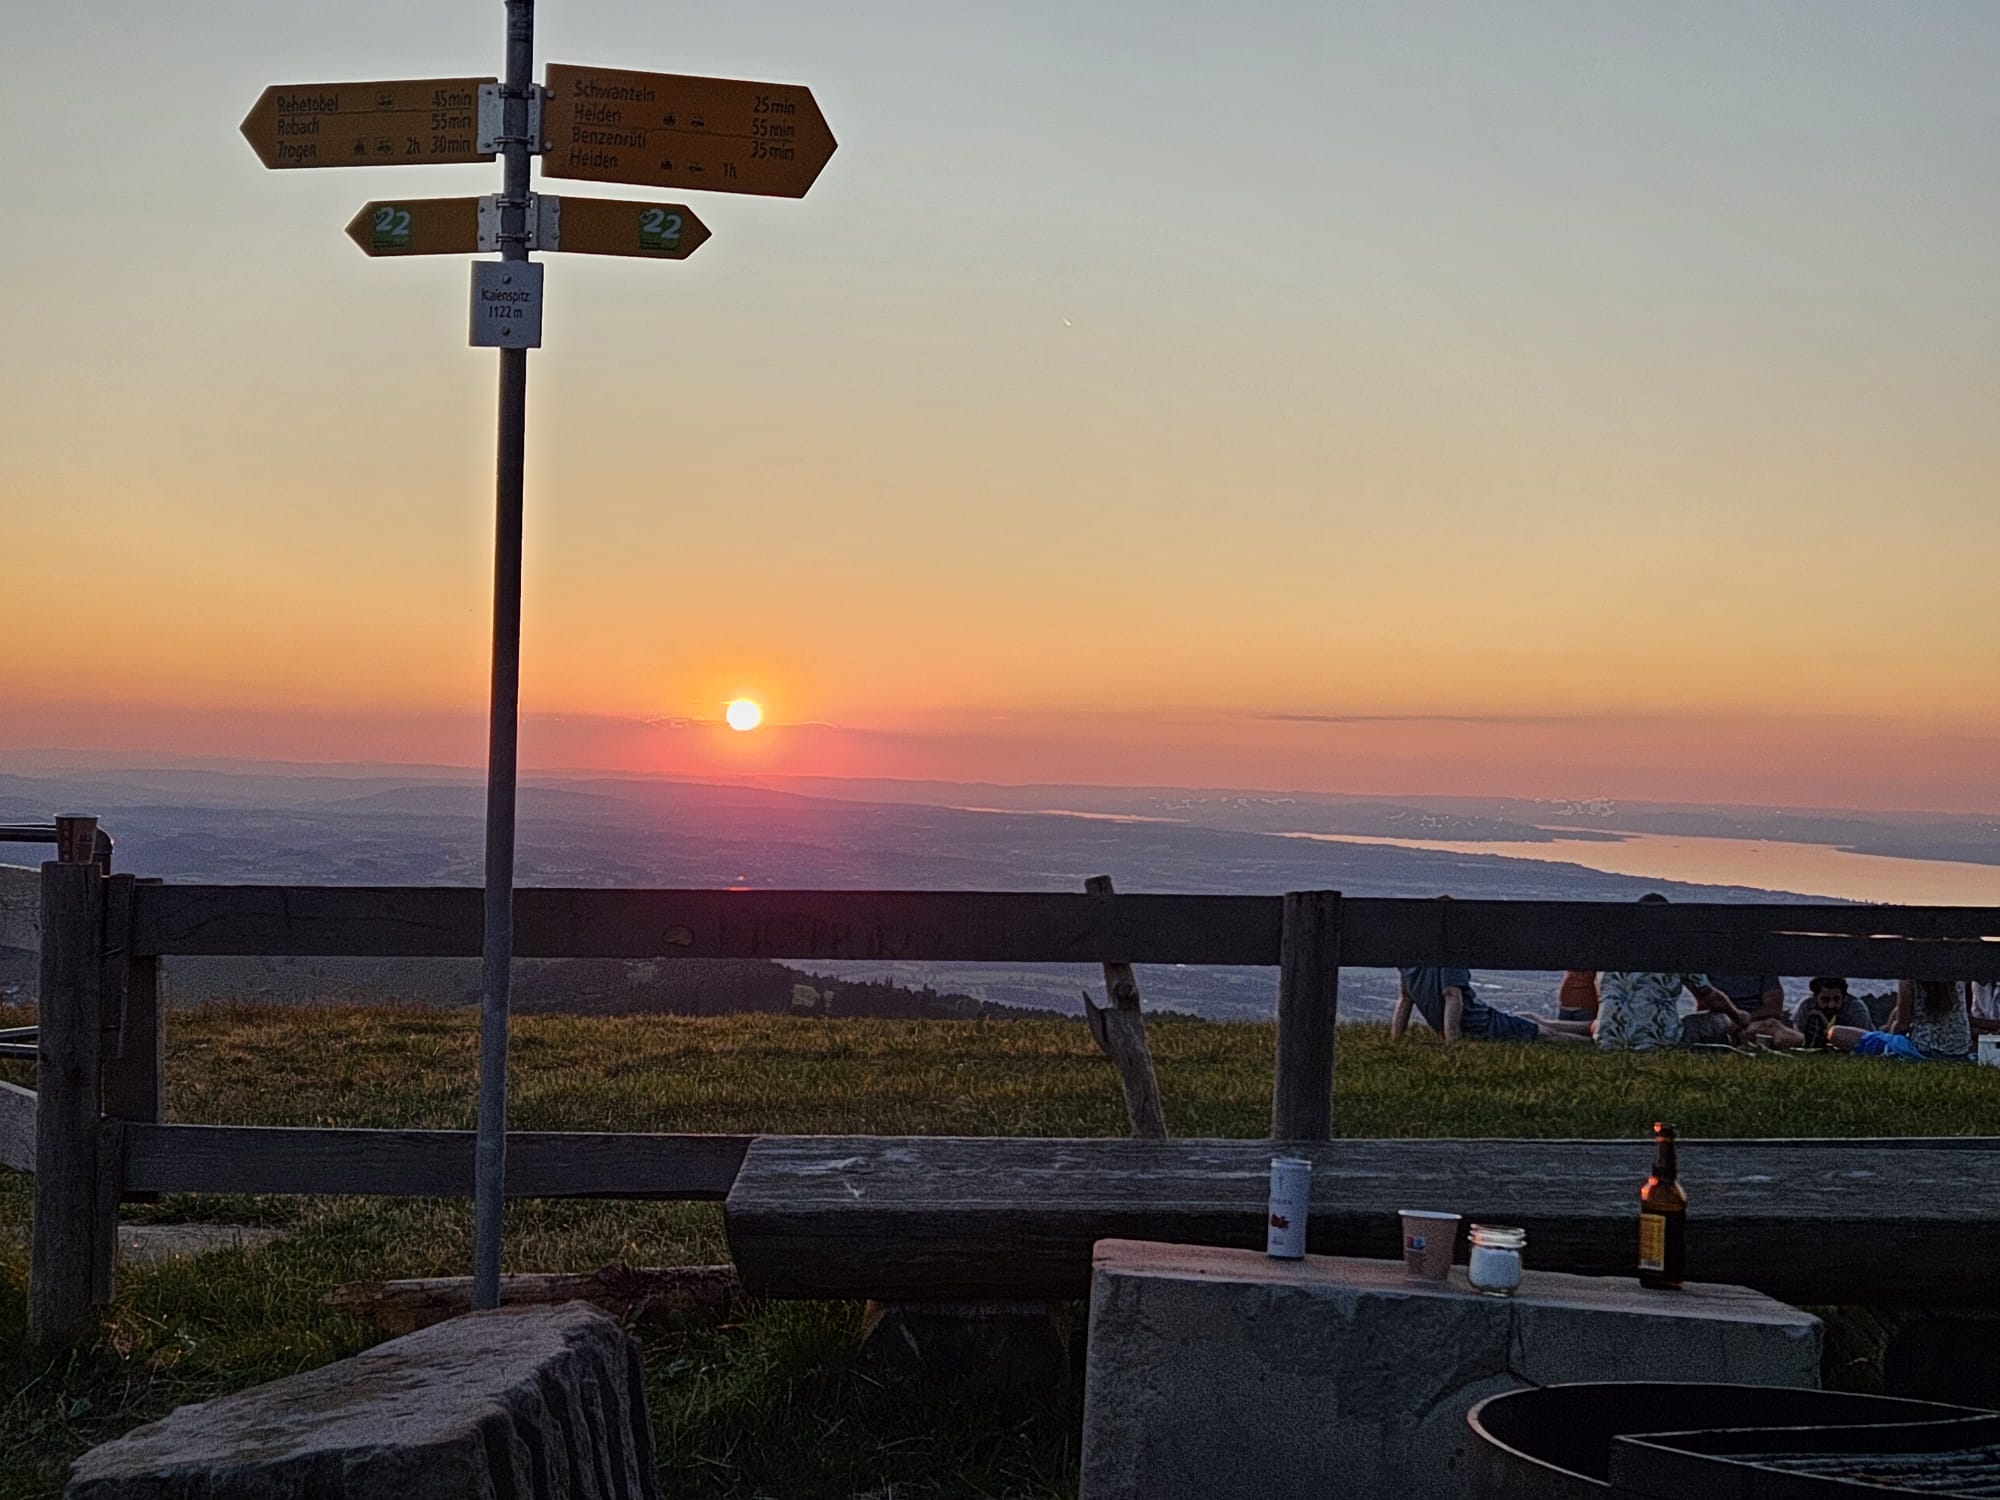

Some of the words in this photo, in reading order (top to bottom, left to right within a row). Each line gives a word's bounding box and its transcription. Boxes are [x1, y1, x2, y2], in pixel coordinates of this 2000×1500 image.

[277, 94, 339, 113] Rehetobel
[574, 103, 620, 123] Heiden
[277, 118, 320, 136] Robach
[277, 141, 317, 163] Trogen
[405, 137, 420, 155] 2h
[570, 149, 618, 168] Heiden
[722, 162, 737, 179] 1h
[375, 206, 411, 236] 22
[643, 208, 682, 239] 22
[481, 288, 530, 305] Kaienspitz
[489, 305, 511, 318] 1122
